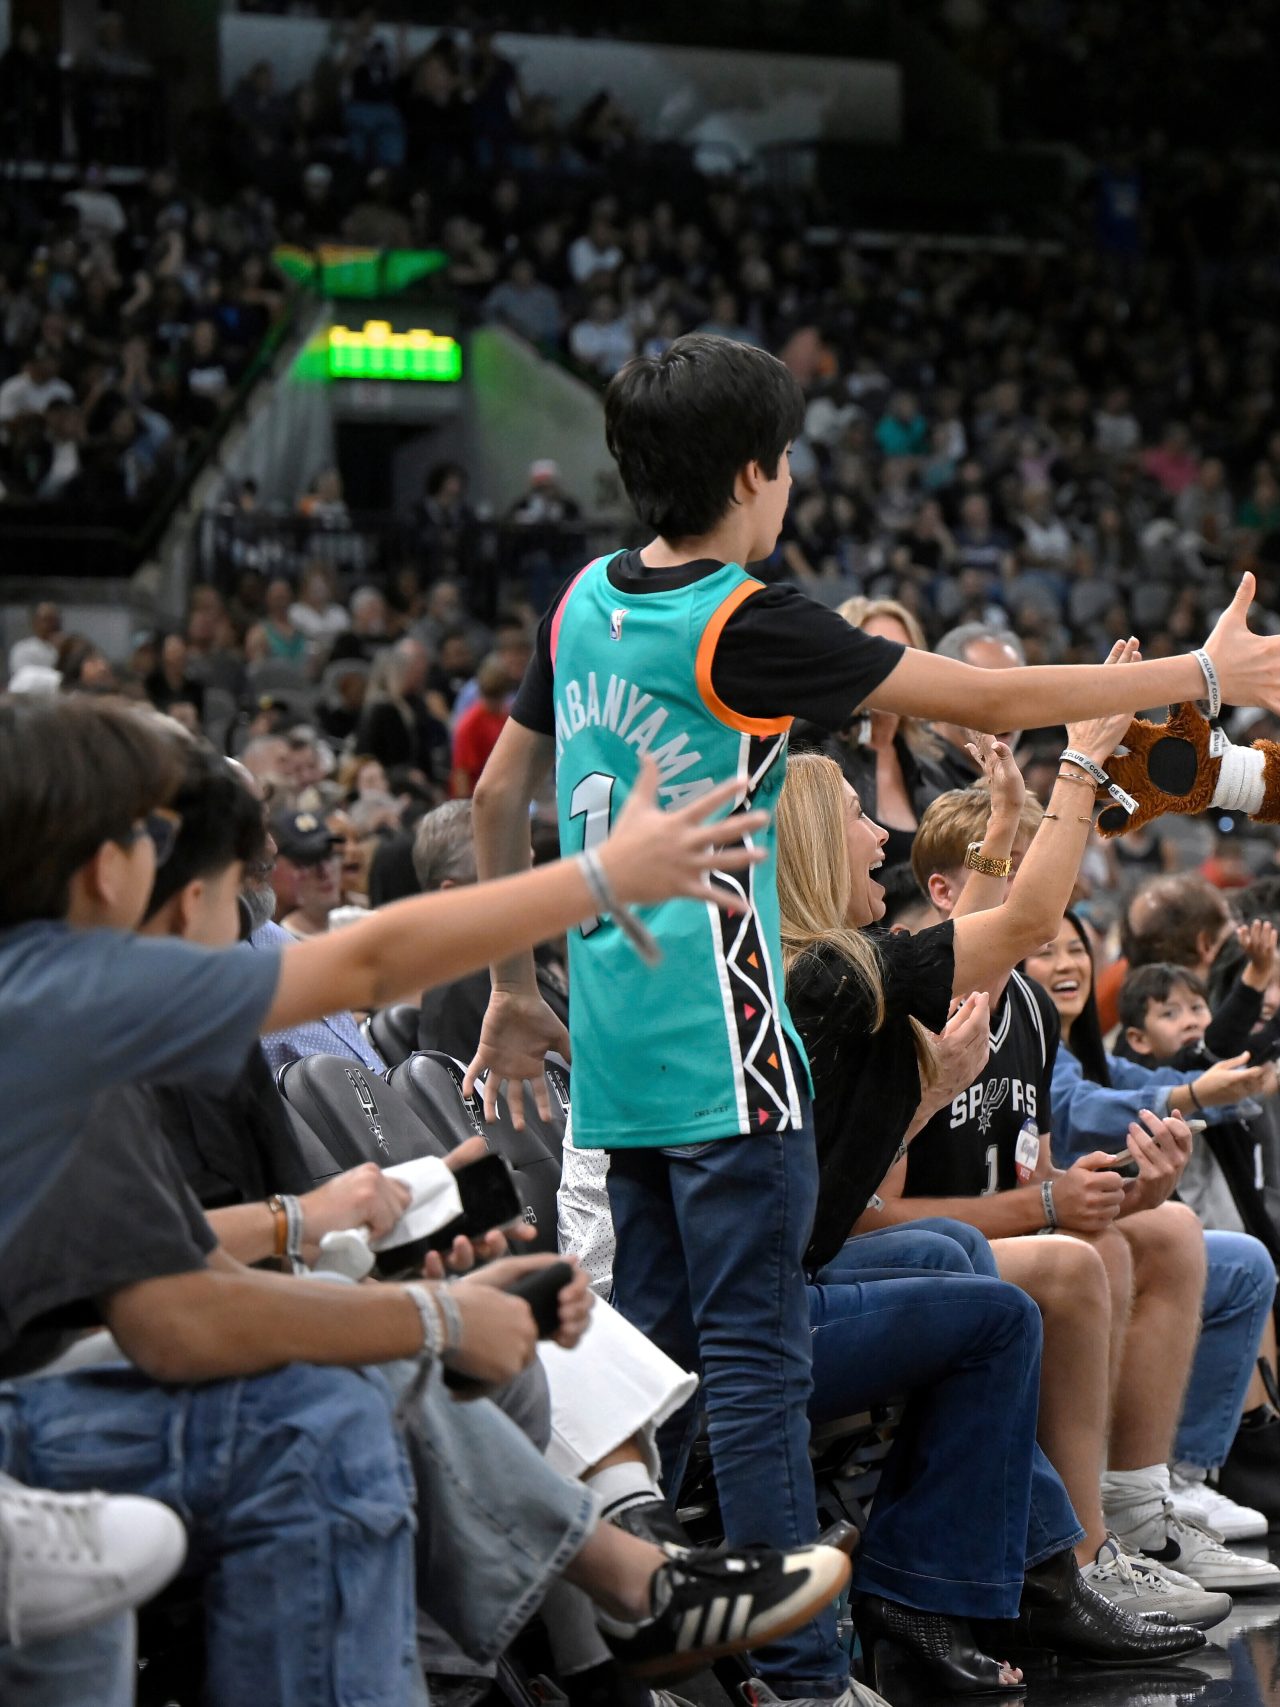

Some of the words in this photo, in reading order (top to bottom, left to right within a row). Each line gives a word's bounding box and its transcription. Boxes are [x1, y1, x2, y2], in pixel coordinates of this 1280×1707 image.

[555, 672, 715, 812] MBANYAMA
[1089, 764, 1106, 782] COUR
[569, 771, 617, 939] 1
[949, 1077, 1037, 1134] SPURS
[980, 1143, 999, 1197] 1
